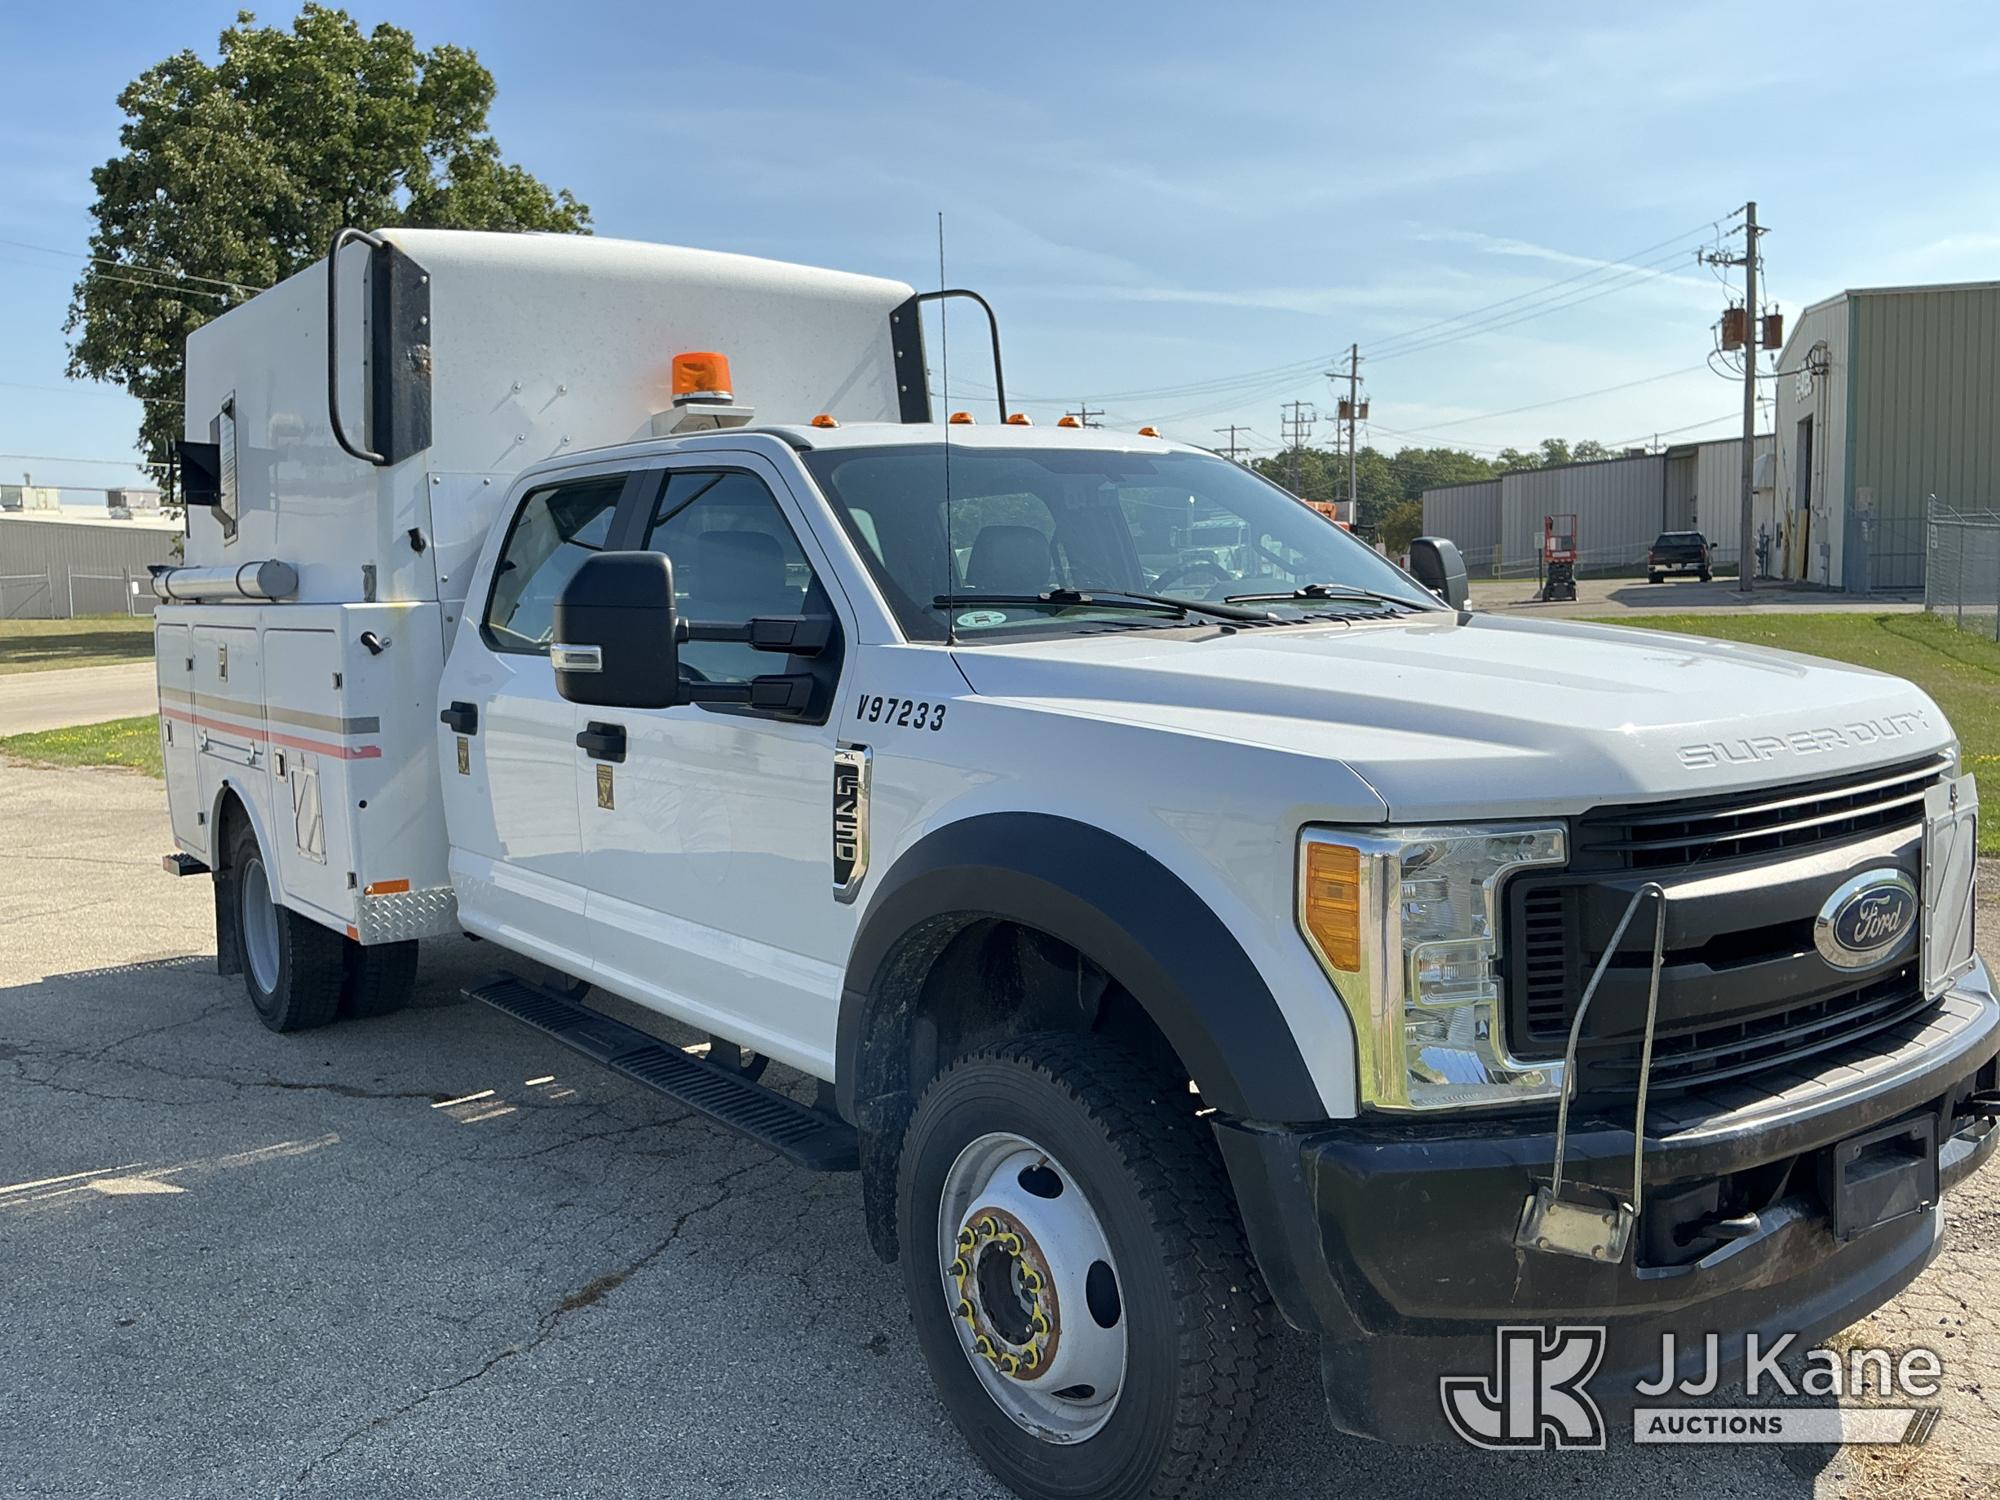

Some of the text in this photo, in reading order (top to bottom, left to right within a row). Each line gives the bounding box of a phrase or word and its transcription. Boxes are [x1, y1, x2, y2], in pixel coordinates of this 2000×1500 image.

[856, 694, 946, 731] V97233
[843, 752, 856, 761] XL
[1674, 710, 1929, 770] SUPER DUTY
[1854, 894, 1902, 942] Ford
